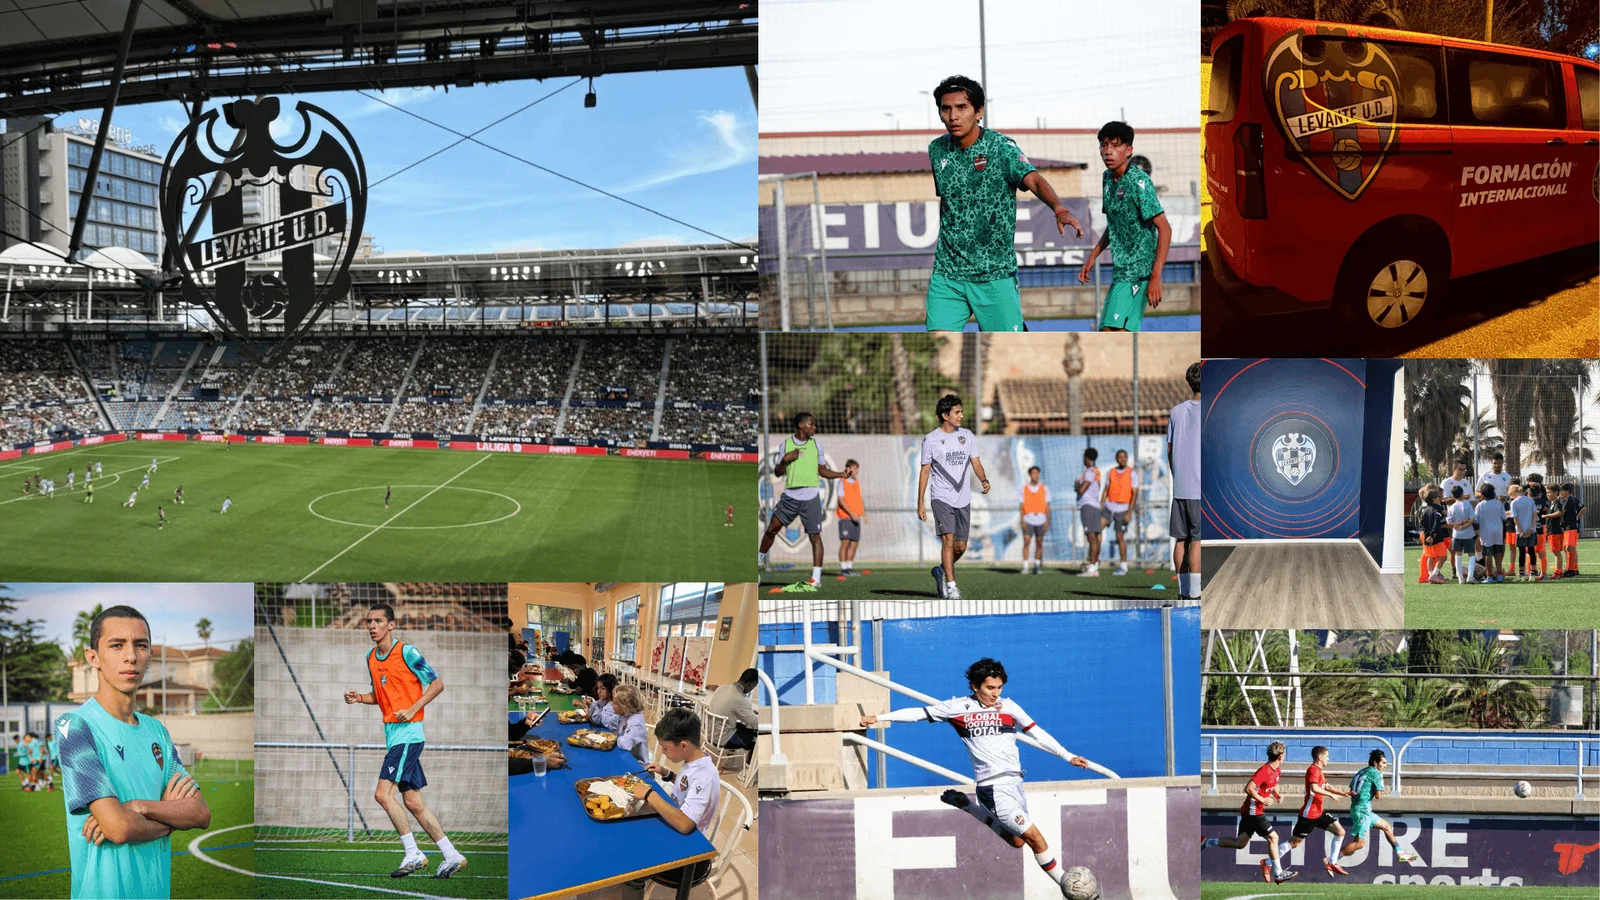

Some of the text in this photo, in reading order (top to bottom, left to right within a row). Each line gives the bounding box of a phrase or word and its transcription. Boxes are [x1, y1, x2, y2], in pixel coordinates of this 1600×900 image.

[1298, 100, 1388, 135] LEVANTE U.D.
[92, 119, 131, 144] aena
[1461, 157, 1572, 186] FORMACIÓN
[1459, 183, 1567, 207] INTERNACIONAL
[200, 210, 335, 266] LEVANTE U.D.
[476, 442, 511, 452] LALIGA
[489, 435, 520, 443] LEVANTE
[963, 713, 1002, 723] GLOBAL
[965, 719, 1003, 729] FOOTBALL
[968, 726, 1002, 738] TOTAL
